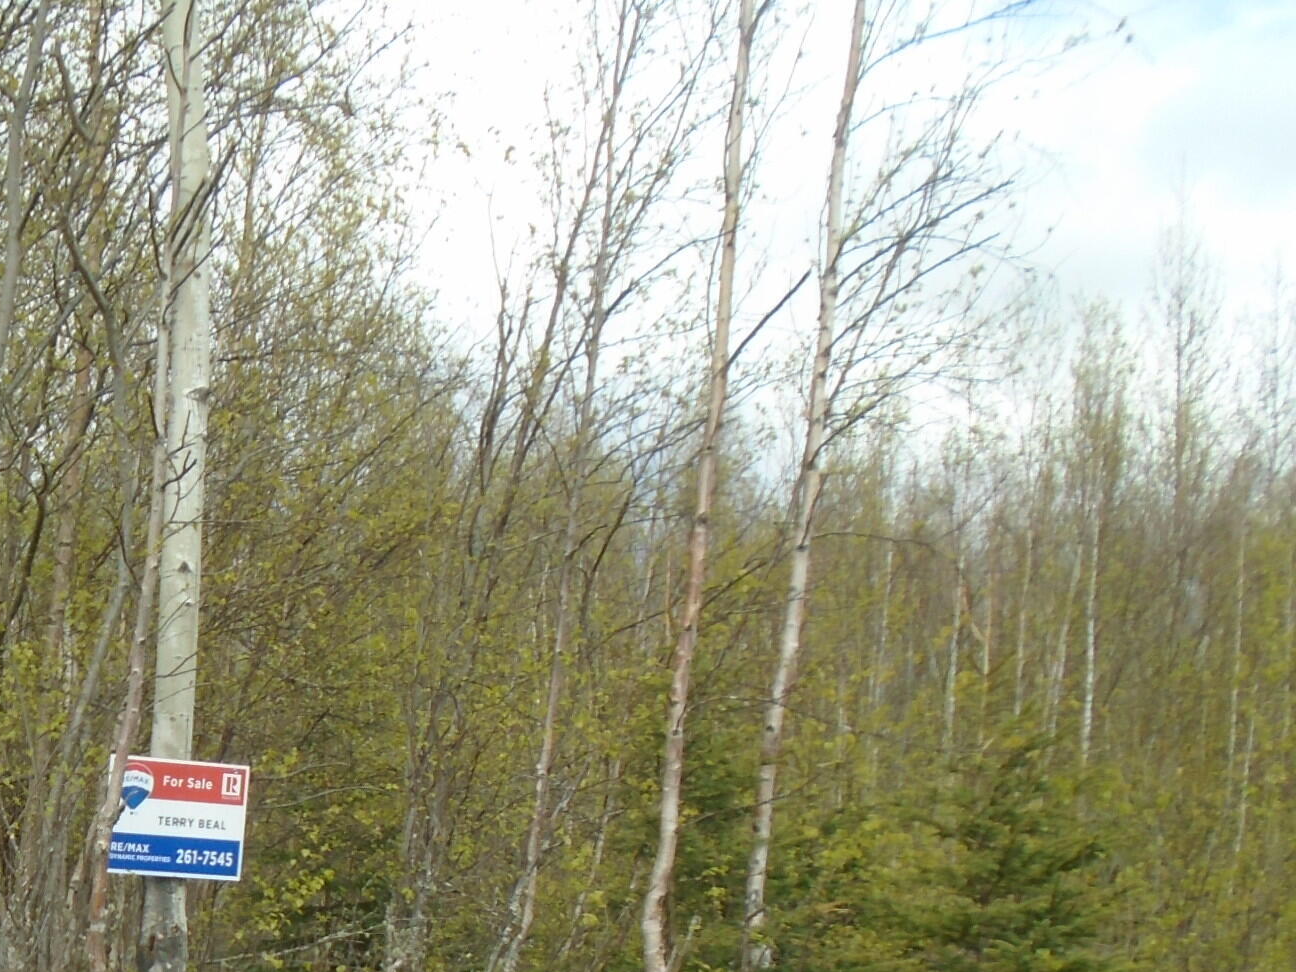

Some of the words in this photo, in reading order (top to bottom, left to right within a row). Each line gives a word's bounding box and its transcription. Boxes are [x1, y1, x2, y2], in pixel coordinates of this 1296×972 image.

[163, 775, 184, 788] For
[187, 777, 213, 790] Sale
[158, 816, 194, 828] TERRY
[198, 819, 226, 830] BEAL
[110, 841, 150, 853] RE/MAX
[175, 849, 233, 867] 261-7545
